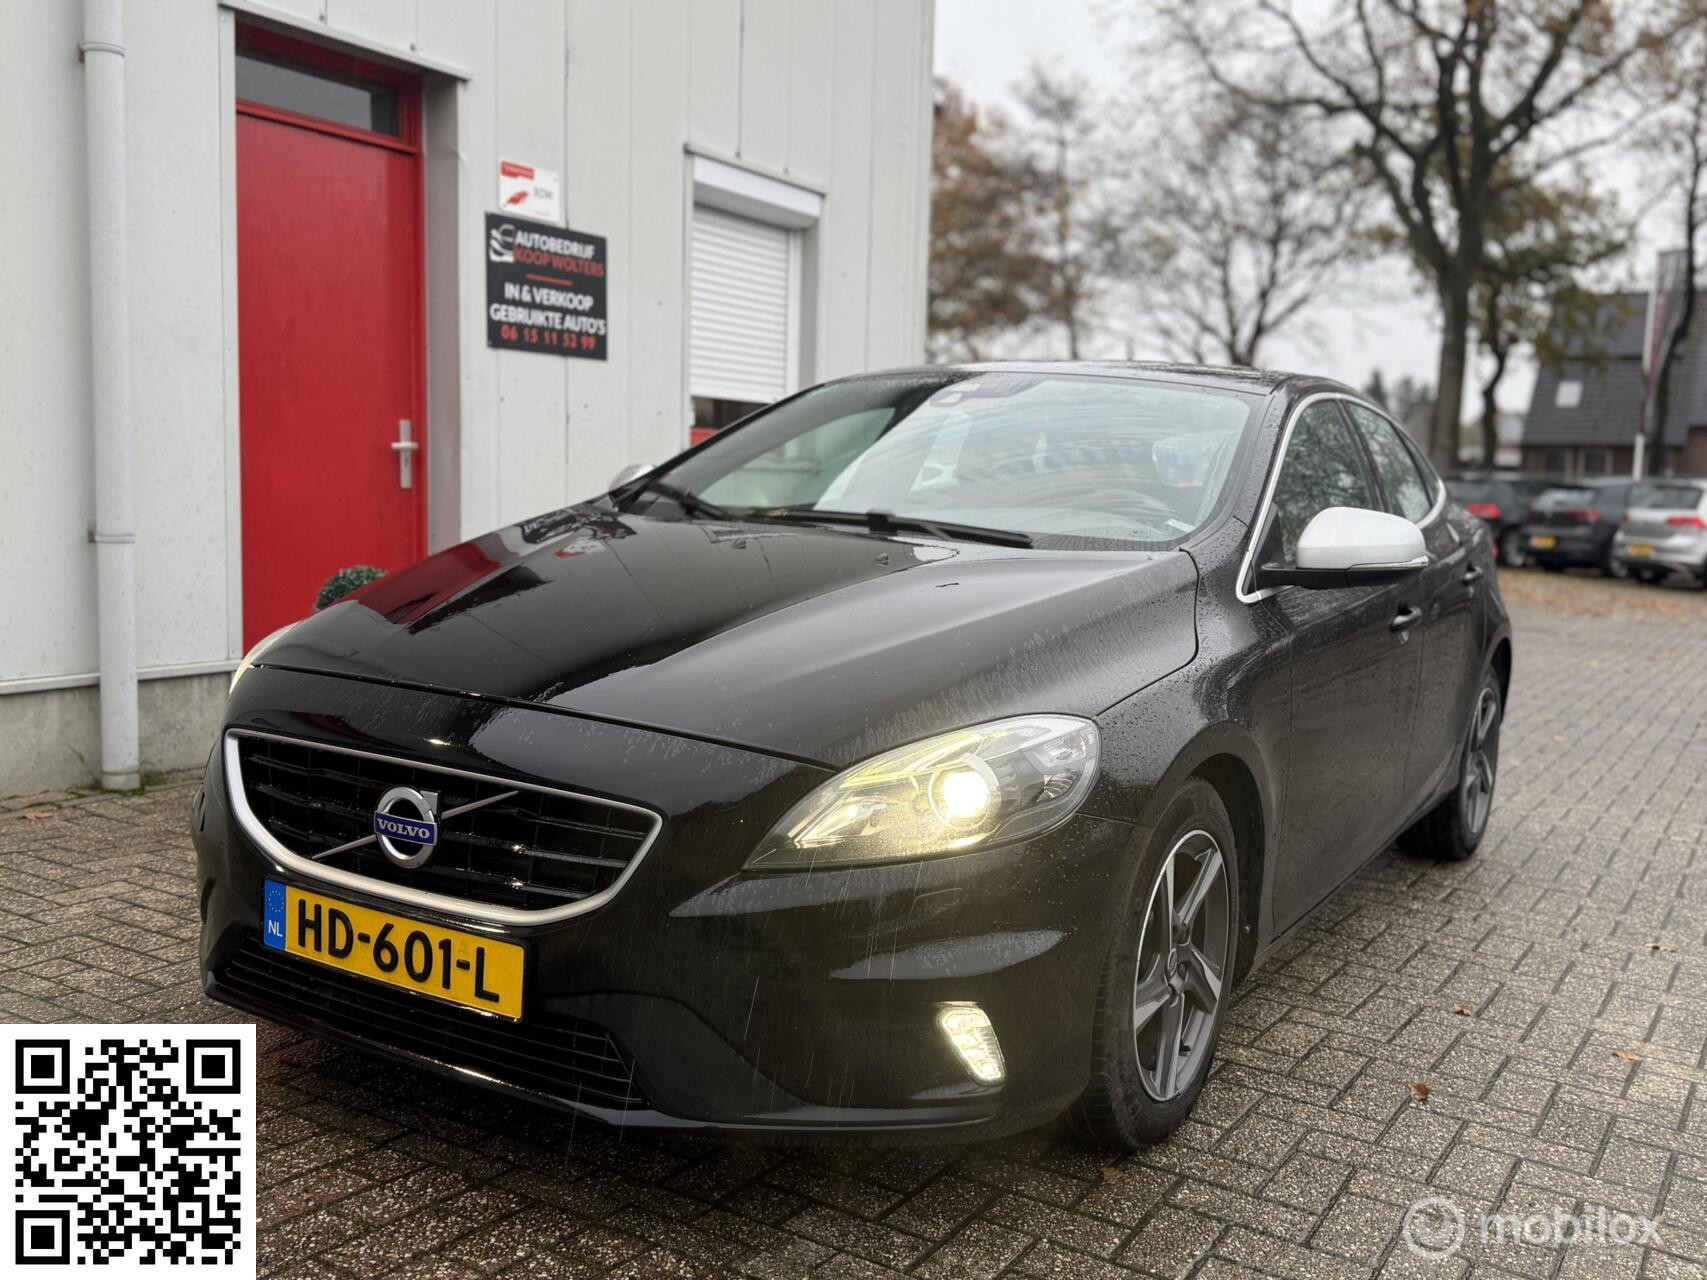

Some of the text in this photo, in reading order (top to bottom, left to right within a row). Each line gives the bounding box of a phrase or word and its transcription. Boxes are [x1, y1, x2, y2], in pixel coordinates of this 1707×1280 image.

[515, 230, 595, 258] AUTOBEDRIJF
[514, 249, 604, 276] KOOP WOLTERS
[505, 282, 593, 311] IN & VERKOOP
[490, 304, 605, 335] GEBRUIKTE AUTO'S
[501, 325, 517, 341] 06
[524, 329, 538, 343] 15
[544, 332, 558, 345] 11
[581, 336, 595, 350] 99
[377, 818, 429, 838] VOLVO
[268, 920, 283, 938] NL
[298, 899, 499, 1002] HD-601-L
